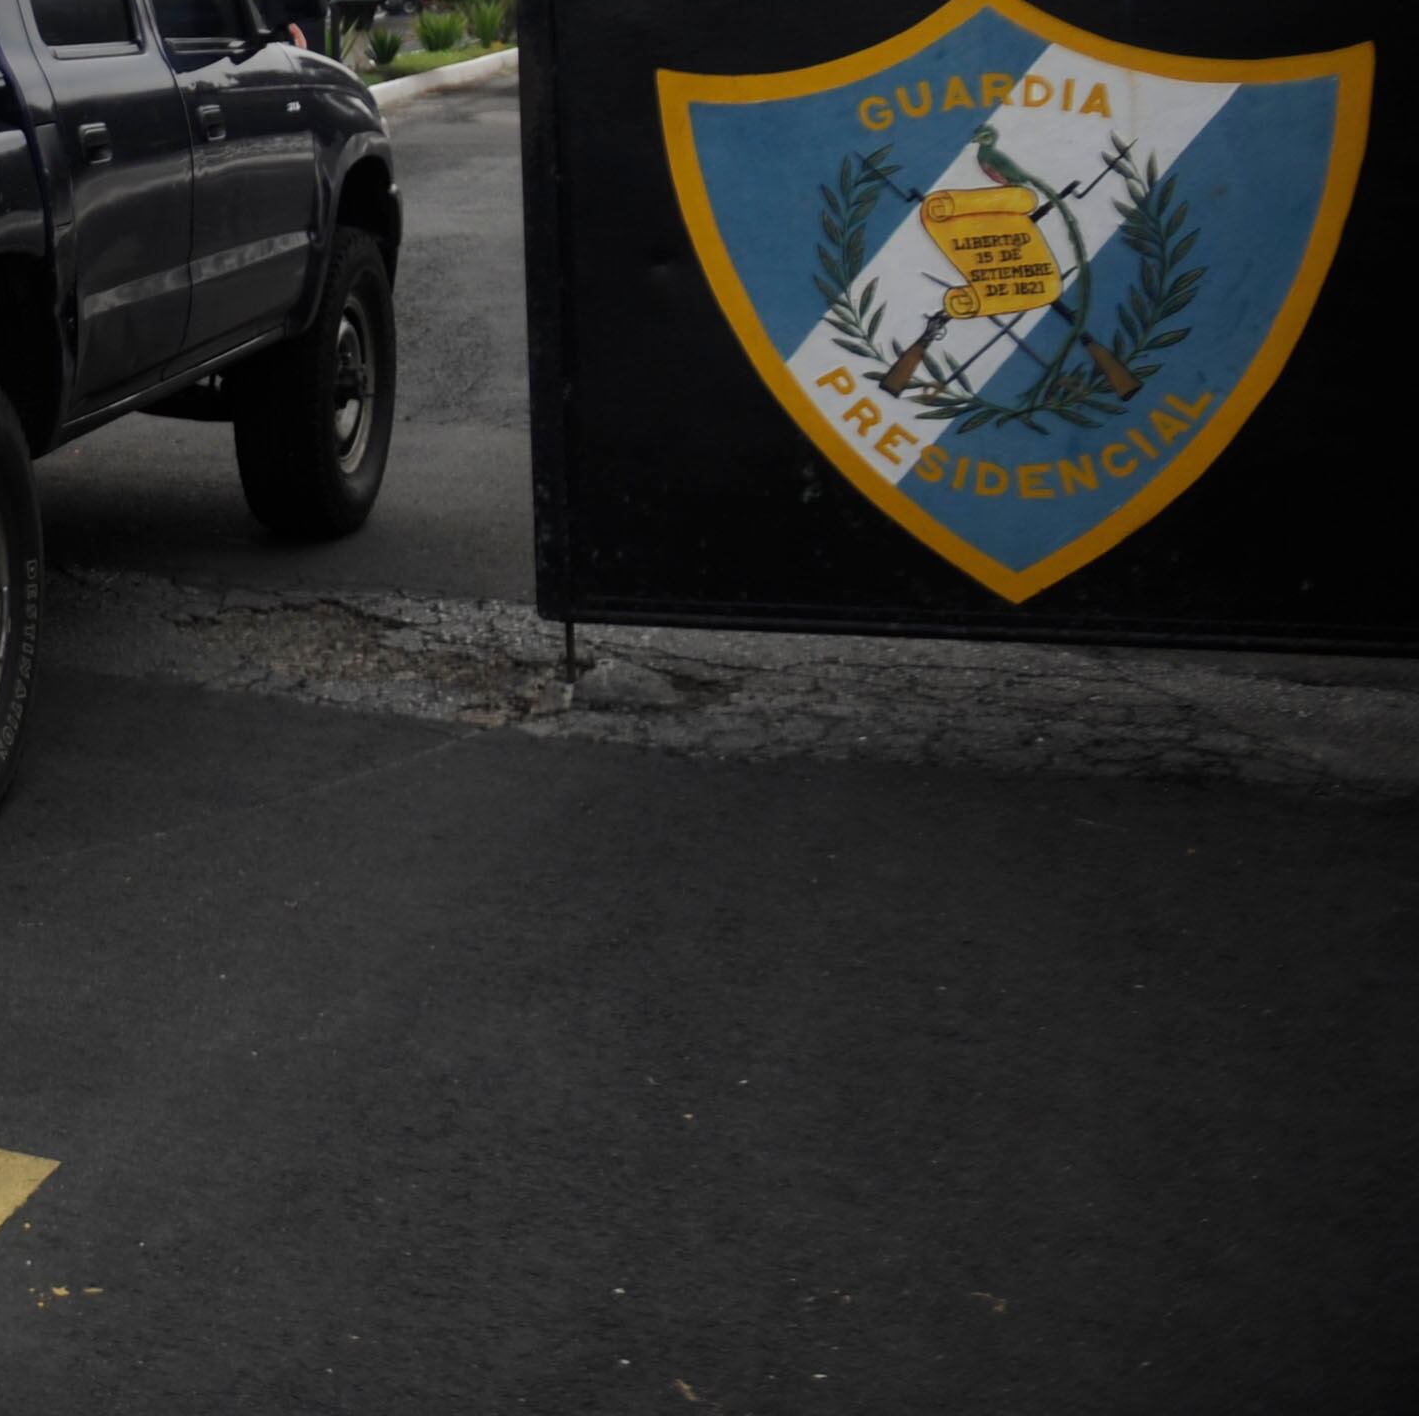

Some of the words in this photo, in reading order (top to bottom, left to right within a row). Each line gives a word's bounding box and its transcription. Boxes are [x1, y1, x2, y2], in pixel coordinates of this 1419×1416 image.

[857, 71, 1113, 131] GUARDIA
[951, 232, 1031, 250] LIBERTAD
[976, 251, 993, 264] 15
[1001, 249, 1021, 261] DE
[970, 263, 1054, 282] SETIEMBRE
[986, 283, 1008, 296] DE
[1015, 280, 1046, 295] 1821
[816, 366, 1214, 499] PRESIDENCIAL
